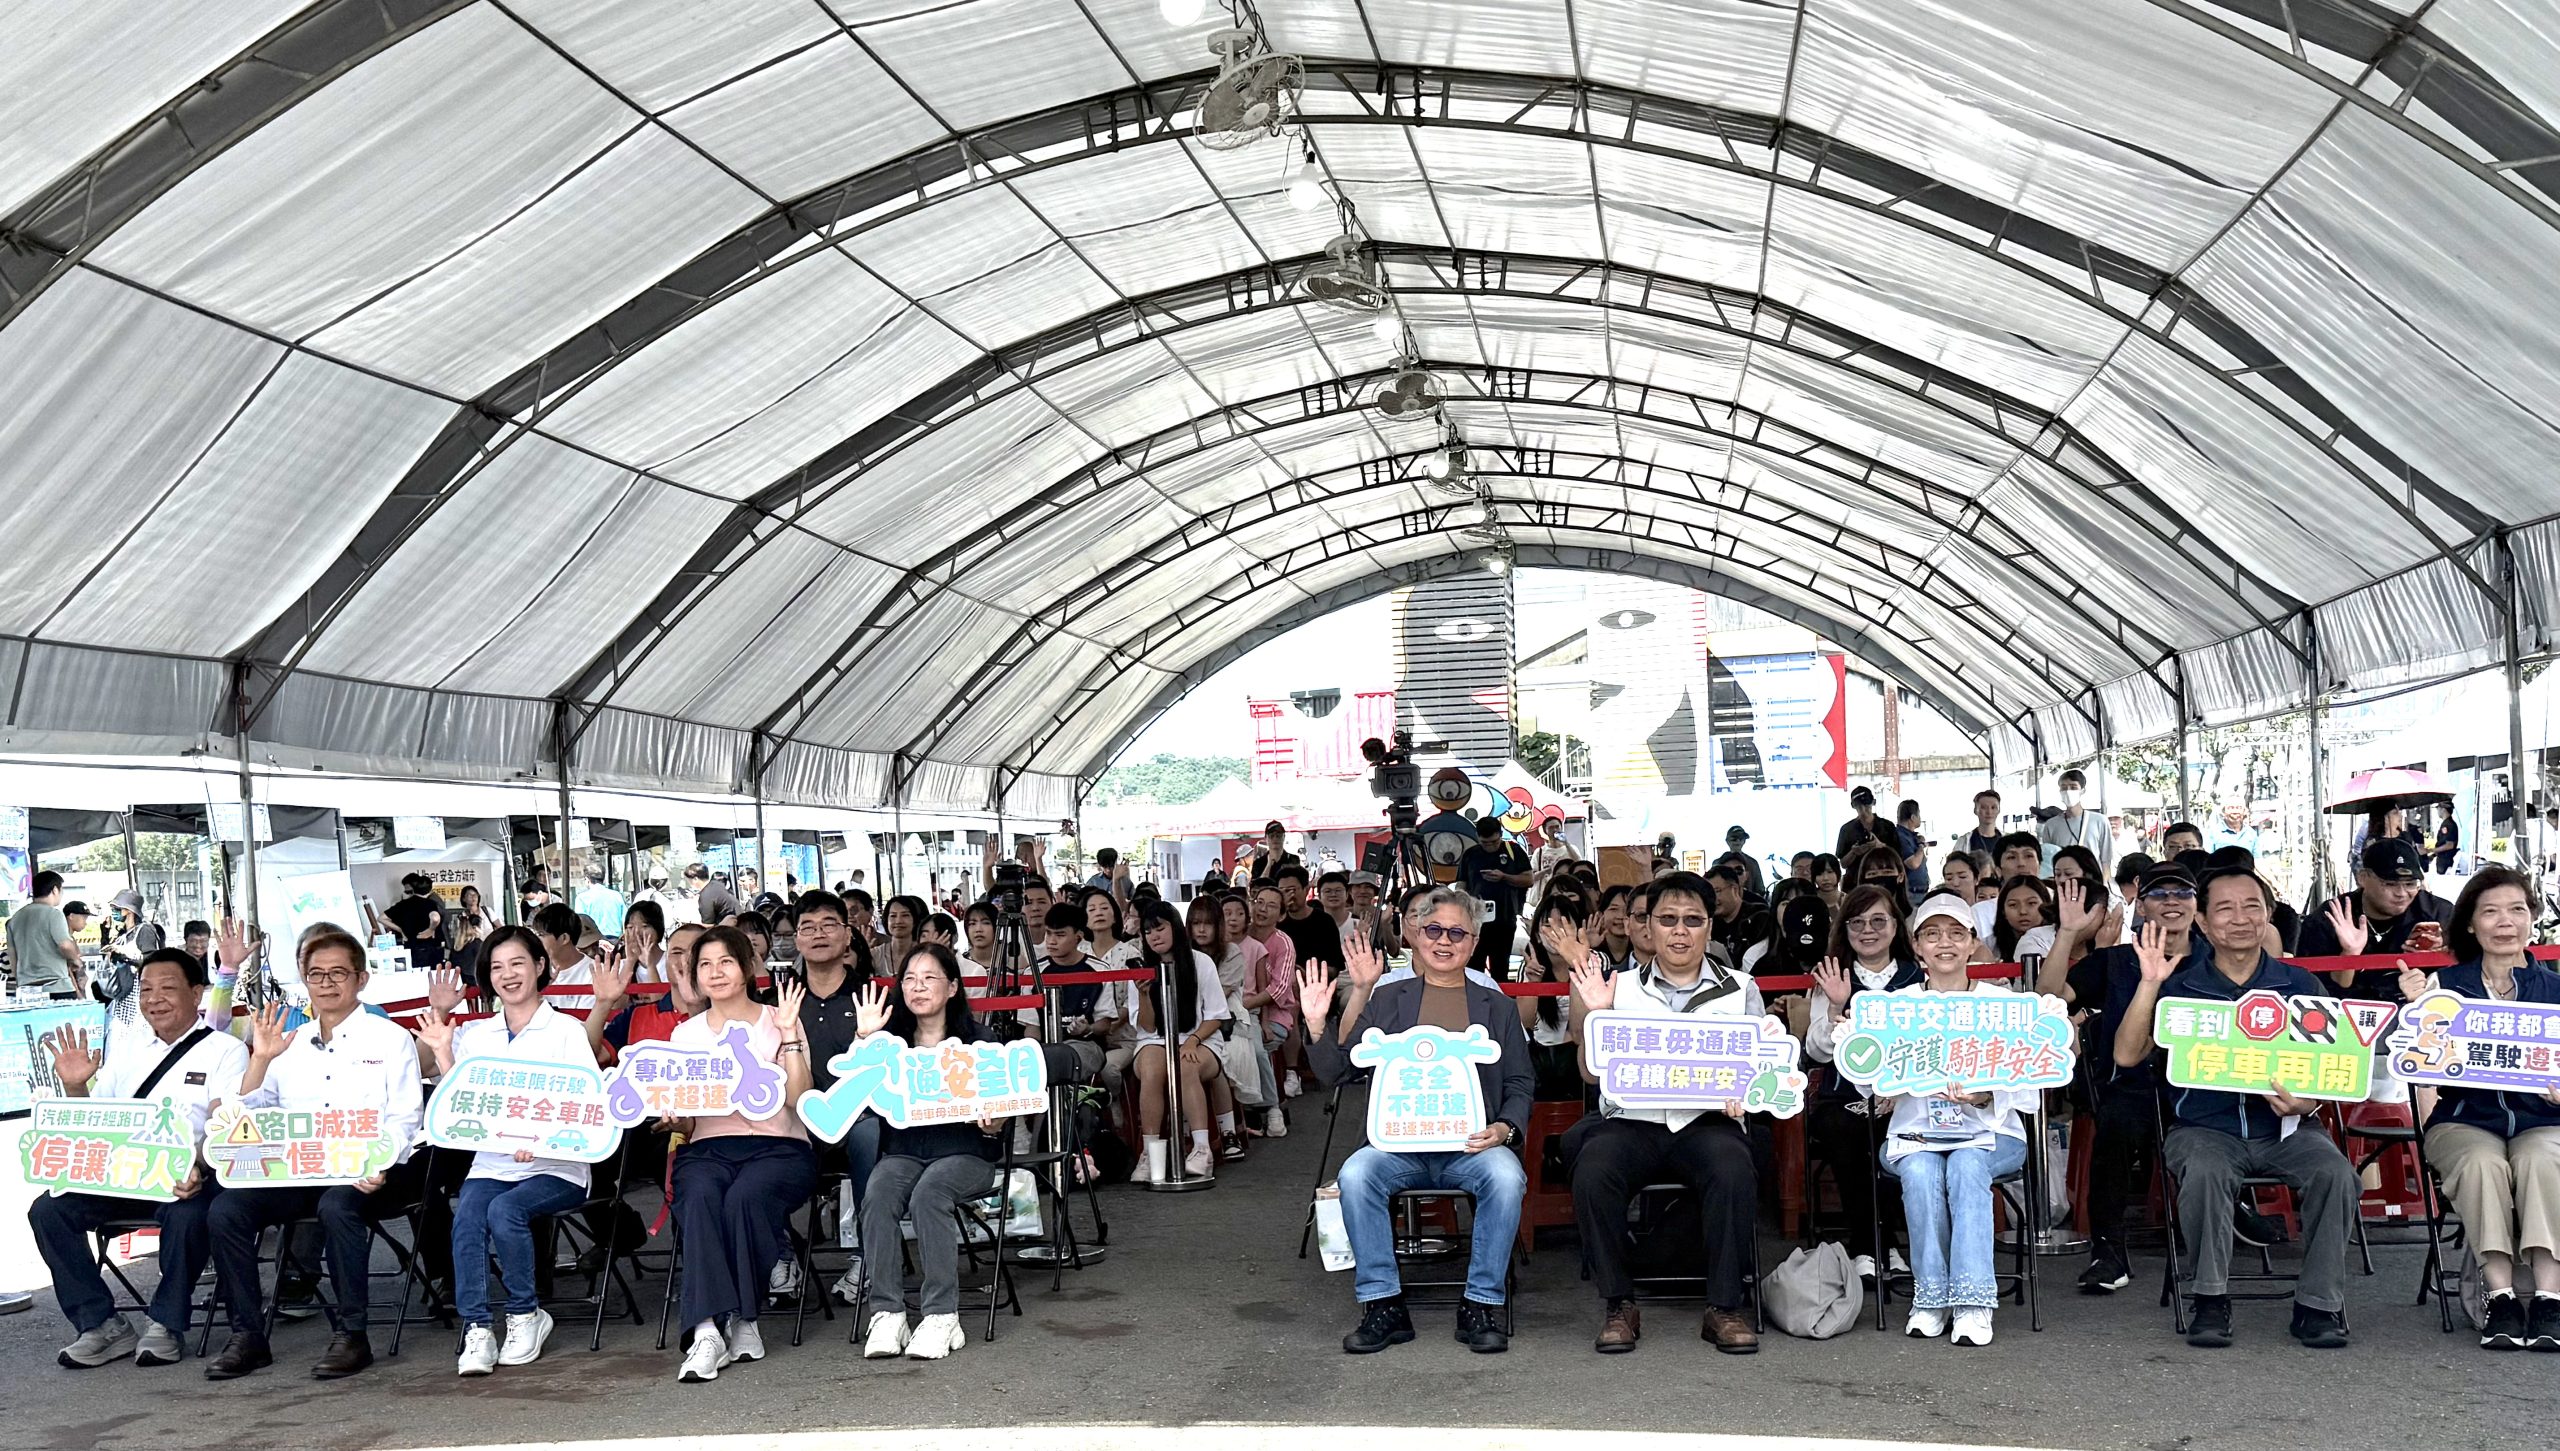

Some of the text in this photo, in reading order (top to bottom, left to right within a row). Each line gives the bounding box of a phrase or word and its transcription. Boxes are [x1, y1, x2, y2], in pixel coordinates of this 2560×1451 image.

[1859, 1001, 2032, 1032] 遵守交通規則
[2165, 1007, 2230, 1040] 看到
[2250, 1006, 2274, 1029] 停
[1602, 1025, 1752, 1057] 騎車毋通趕
[2466, 1041, 2560, 1072] 駕駛遵
[635, 1057, 733, 1081] 專心駕駛
[1887, 1034, 2064, 1082] 守護騎車安全
[2187, 1044, 2359, 1093] 停車再開
[469, 1066, 587, 1094] 請依速限行駛
[1399, 1065, 1453, 1091] 安全
[1613, 1062, 1737, 1092] 停讓保平安
[450, 1090, 604, 1127] 保持安全車距
[646, 1085, 728, 1109] 不超速
[1388, 1093, 1466, 1117] 不超速
[42, 1108, 147, 1127] 汽機車行經路口
[256, 1109, 378, 1140] 路口減速
[1385, 1121, 1468, 1136] 超速煞不住
[32, 1137, 177, 1191] 停讓行人
[286, 1141, 367, 1176] 慢行
